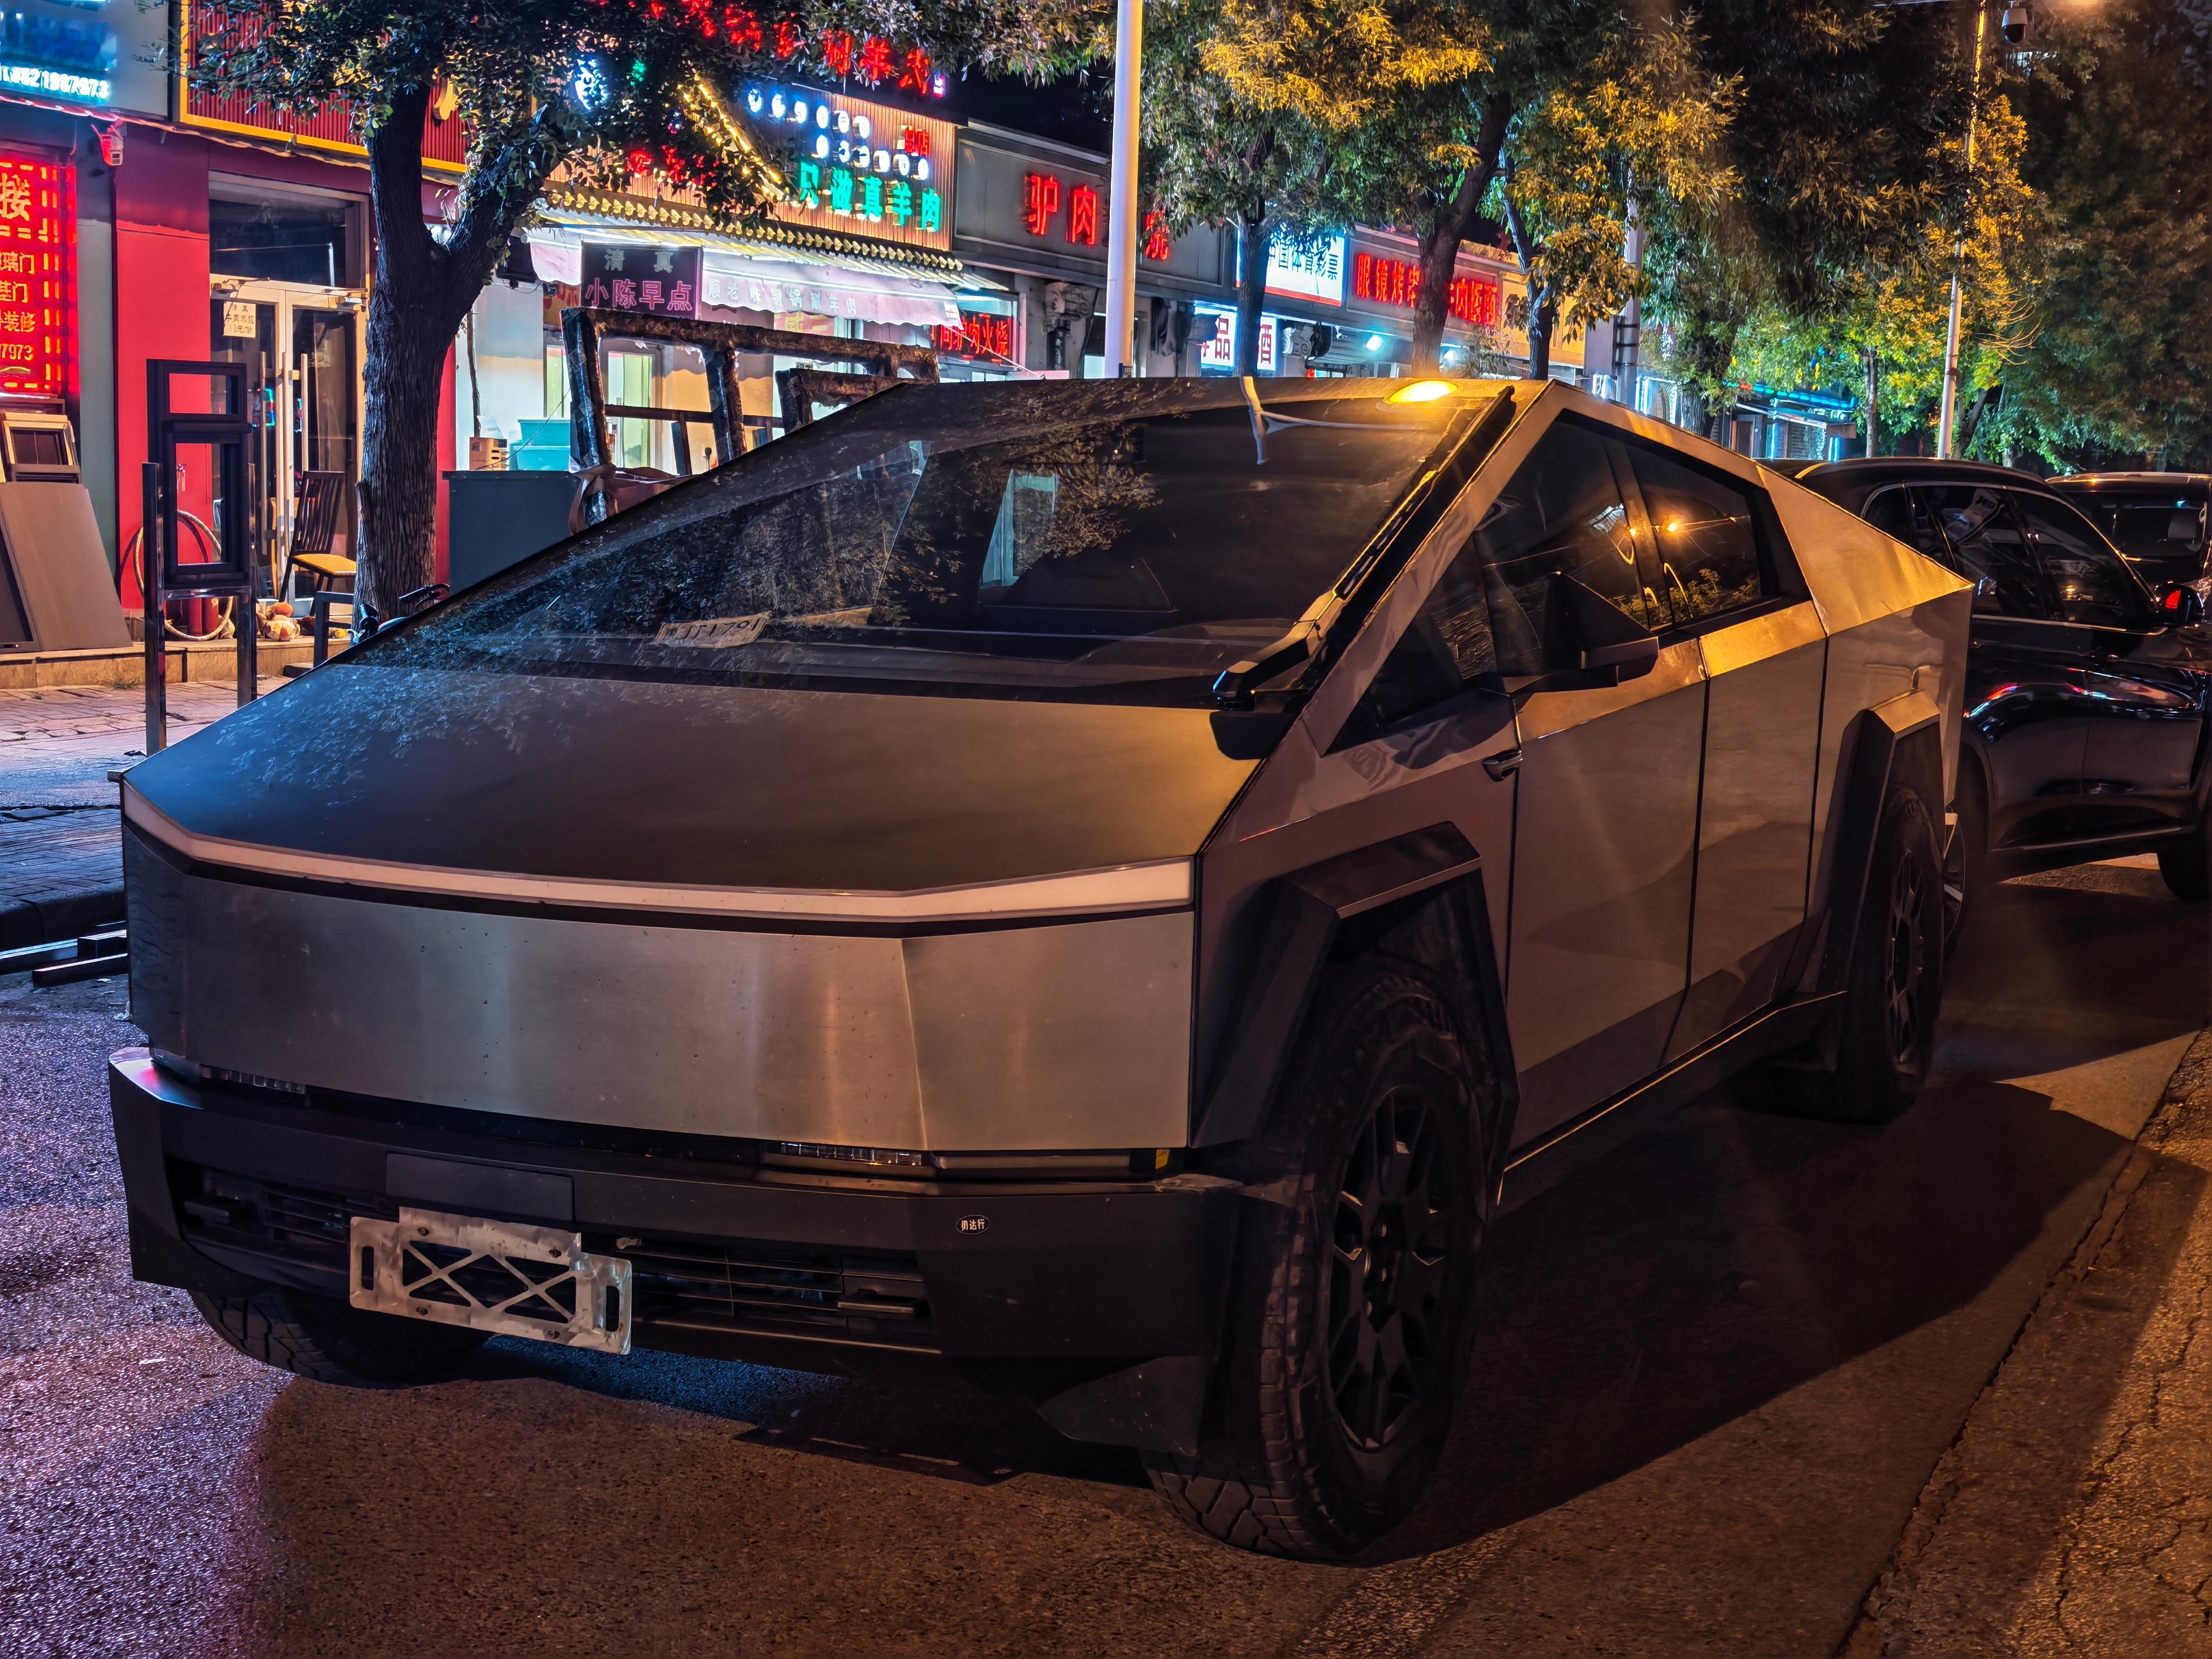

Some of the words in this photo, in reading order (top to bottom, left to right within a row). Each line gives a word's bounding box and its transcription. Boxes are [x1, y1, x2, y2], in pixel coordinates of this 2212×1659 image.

[799, 160, 940, 232] 只做真羊肉
[0, 251, 35, 274] 璃门
[604, 248, 674, 273] 清真
[585, 278, 693, 312] 小陈早点
[0, 309, 36, 332] 装修
[930, 315, 1009, 356] 间驴肉火烧
[0, 343, 33, 361] 7973
